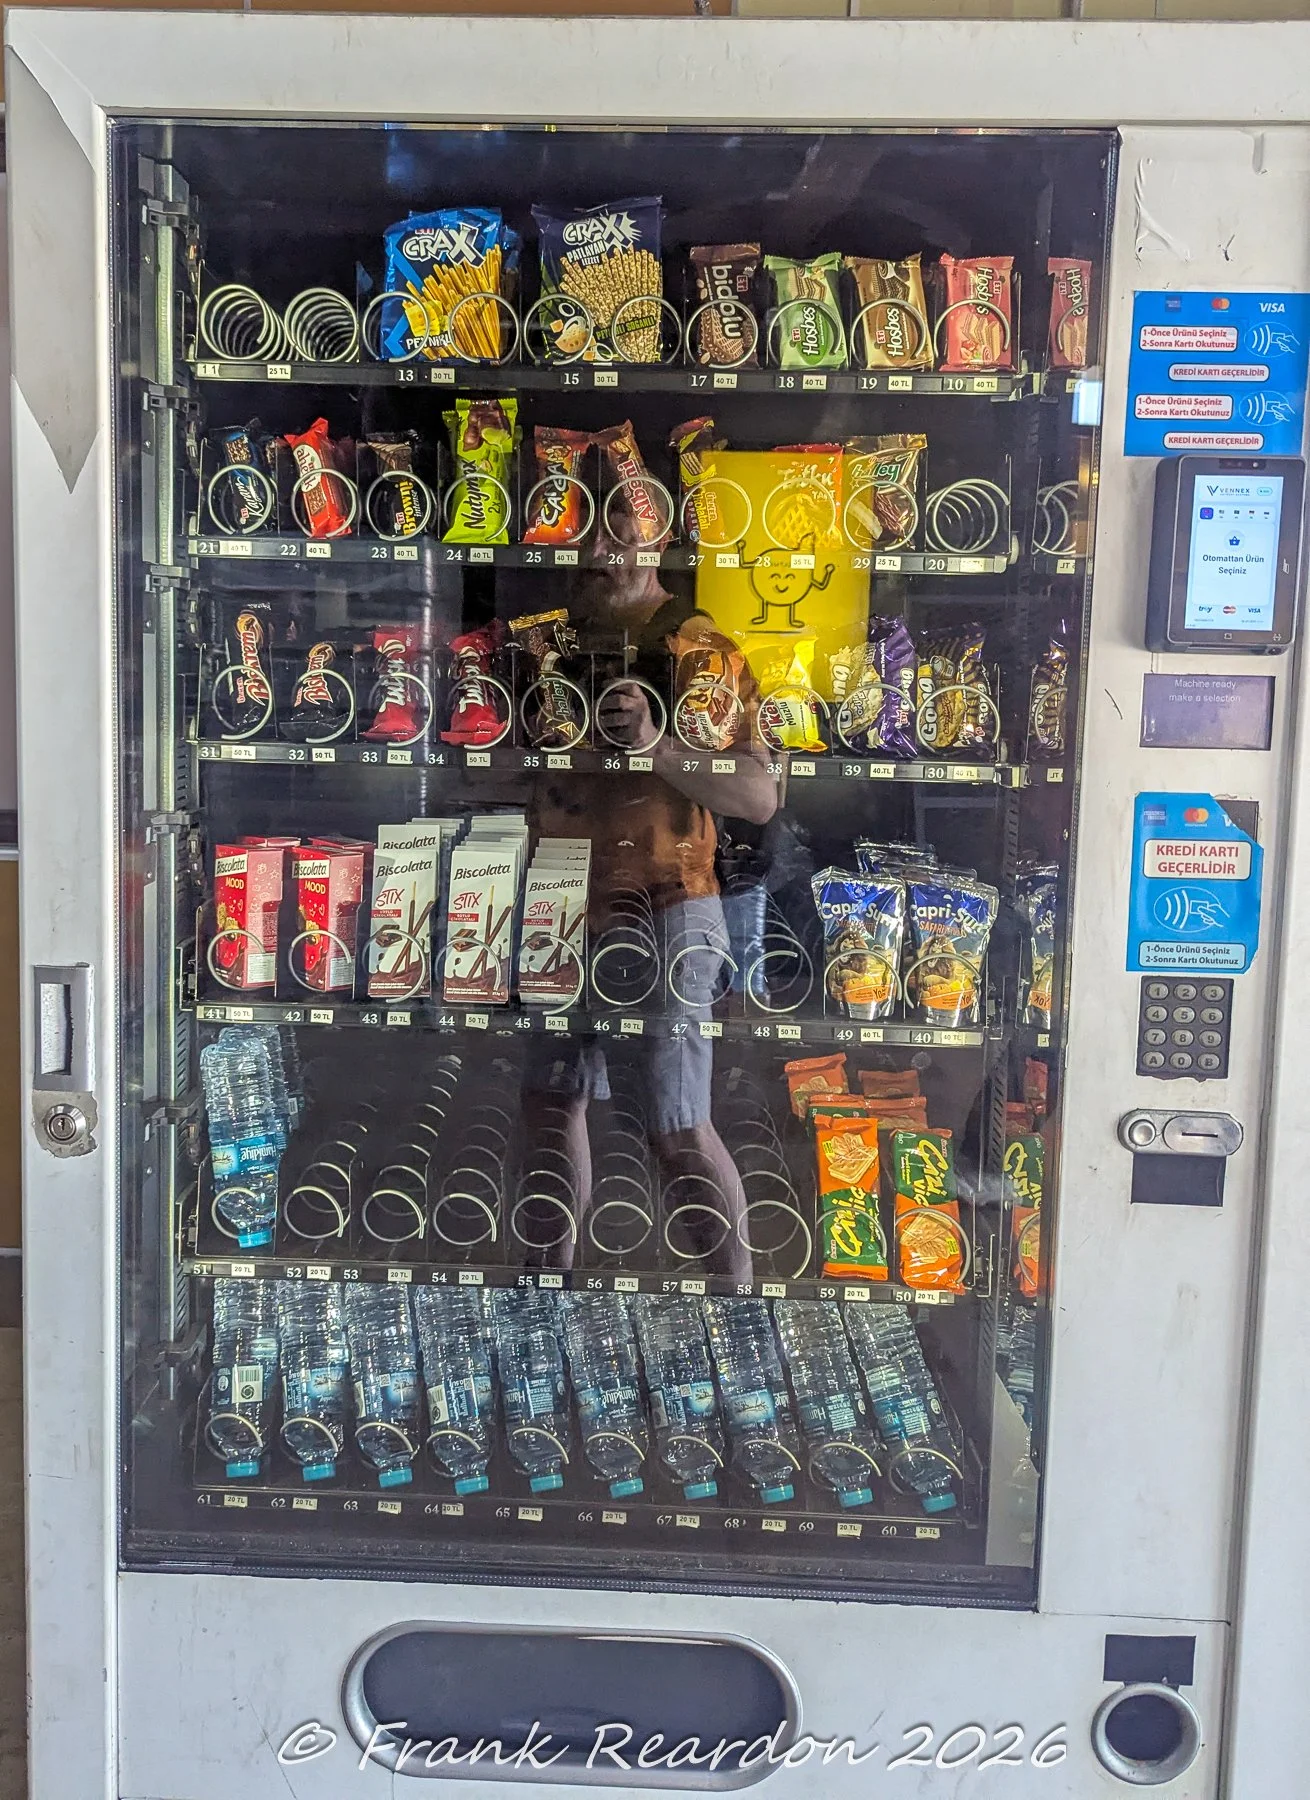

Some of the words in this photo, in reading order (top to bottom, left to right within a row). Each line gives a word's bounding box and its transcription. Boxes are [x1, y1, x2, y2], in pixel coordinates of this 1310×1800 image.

[563, 213, 633, 248] CRAX
[403, 222, 485, 268] CRAX
[566, 240, 606, 262] PATLAYAN
[581, 256, 600, 266] LEZZET
[712, 265, 742, 339] bidolu
[1259, 303, 1285, 313] VISA
[1143, 328, 1171, 337] 1-Önce
[1172, 328, 1197, 337] Ürünü
[1199, 329, 1227, 338] Seçiniz
[1142, 340, 1172, 348] 2-Sonra
[1174, 340, 1194, 348] Kartı
[1195, 340, 1235, 348] Okutunuz
[1173, 367, 1196, 376] KREDİ
[1198, 368, 1220, 376] KARTI
[1221, 368, 1265, 378] GEÇERLİDİR
[564, 373, 579, 385] 15
[691, 375, 707, 386] 17
[861, 378, 877, 389] 19
[1138, 397, 1165, 405] 1-Önce
[1167, 397, 1192, 405] Ürünü
[1194, 398, 1222, 407] Seçiniz
[1190, 409, 1229, 417] Okutunuz
[1168, 436, 1191, 444] KREDİ
[1192, 437, 1214, 445] KARTI
[1215, 436, 1259, 446] GEÇERLİDİR
[297, 449, 316, 490] ahek
[617, 459, 658, 522] Albeni
[488, 502, 501, 514] 2x
[371, 547, 387, 558] 23
[526, 552, 541, 563] 25
[608, 553, 624, 564] 26
[1203, 555, 1244, 563] Otomattan
[1245, 554, 1265, 563] Ürün
[1219, 567, 1247, 575] Seçiniz
[303, 655, 333, 705] Biskem
[1175, 679, 1210, 688] Machine
[1213, 680, 1236, 689] ready
[1169, 693, 1193, 701] make
[1203, 694, 1241, 702] selection
[289, 750, 304, 760] 32
[524, 756, 539, 767] 35
[766, 764, 782, 774] 38
[1156, 843, 1196, 856] KREDİ
[1199, 846, 1239, 858] KARTI
[216, 859, 246, 875] Biscolata
[294, 863, 328, 876] Biscolata
[376, 860, 433, 878] Biscolata
[453, 864, 511, 880] Biscolata
[1158, 860, 1236, 876] GEÇERLİDİR
[225, 877, 245, 889] MOOD
[304, 882, 326, 893] MOOD
[528, 879, 583, 893] Biscolata
[376, 888, 405, 907] STIX
[453, 892, 483, 911] STIX
[528, 901, 556, 917] STIX
[1147, 944, 1174, 953] 1-Önce
[1176, 945, 1201, 954] Ürünü
[1202, 946, 1231, 955] Seçiniz
[1177, 956, 1198, 964] Kartı
[1199, 957, 1239, 965] Okutunuz
[1154, 987, 1161, 996] 1
[1182, 989, 1190, 997] 2
[1210, 989, 1218, 998] 3
[362, 1013, 378, 1023] 43
[1152, 1010, 1160, 1019] 4
[1181, 1011, 1189, 1020] 5
[1208, 1012, 1216, 1021] 6
[515, 1018, 531, 1028] 45
[1151, 1033, 1159, 1042] 7
[1179, 1034, 1187, 1043] 8
[1207, 1034, 1215, 1044] 9
[1149, 1056, 1158, 1065] A
[1205, 1058, 1213, 1067] B
[286, 1267, 301, 1277] 52
[587, 1278, 602, 1288] 56
[737, 1284, 752, 1295] 58
[271, 1498, 285, 1508] 62
[657, 1515, 672, 1525] 67
